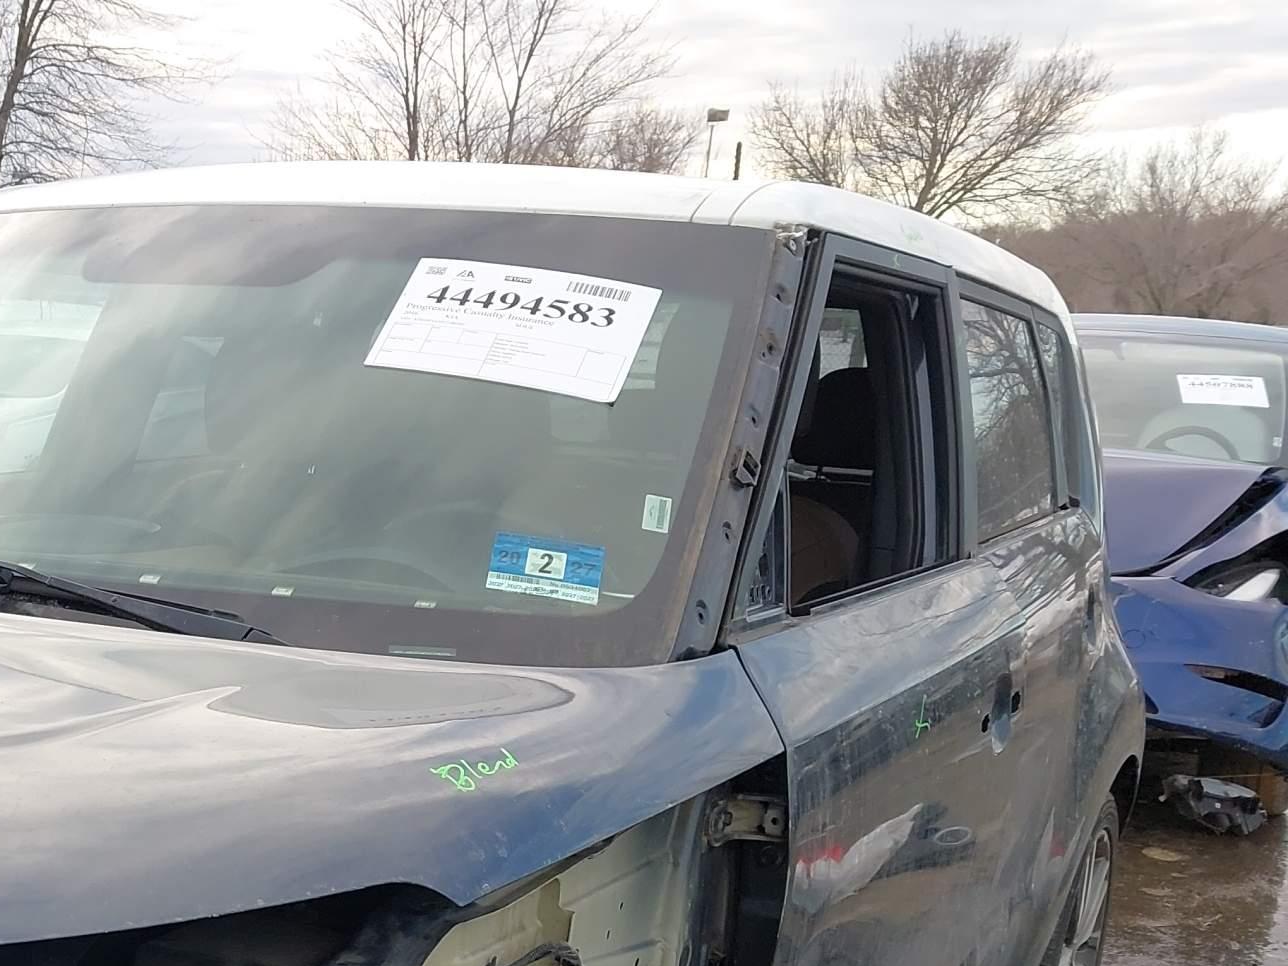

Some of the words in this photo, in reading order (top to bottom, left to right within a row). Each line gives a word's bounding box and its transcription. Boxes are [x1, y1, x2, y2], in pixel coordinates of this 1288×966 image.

[405, 302, 461, 315] Progressive
[464, 308, 505, 320] Casualty
[508, 314, 555, 327] Insurance
[426, 284, 617, 328] 44494583
[538, 553, 554, 575] 2
[429, 747, 520, 792] Blend
